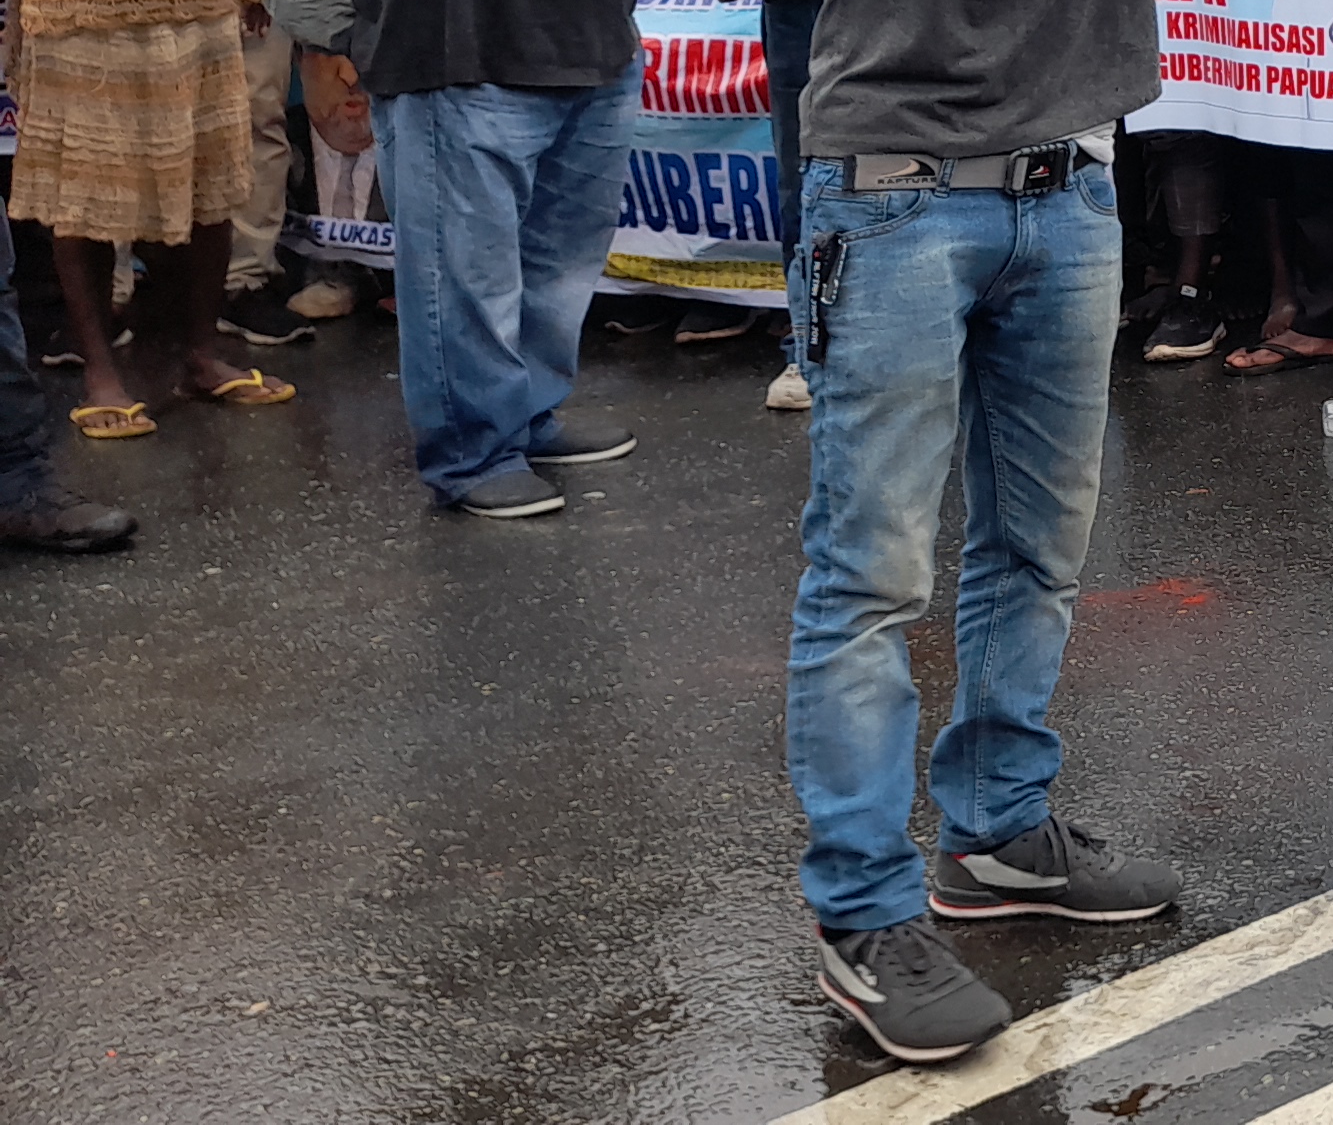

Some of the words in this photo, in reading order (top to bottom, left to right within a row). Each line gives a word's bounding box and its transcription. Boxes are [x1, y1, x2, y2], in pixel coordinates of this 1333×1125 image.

[1165, 10, 1325, 57] KRIMINALISASI
[1159, 52, 1261, 93] GUBERNUR
[328, 222, 393, 246] LUKAS
